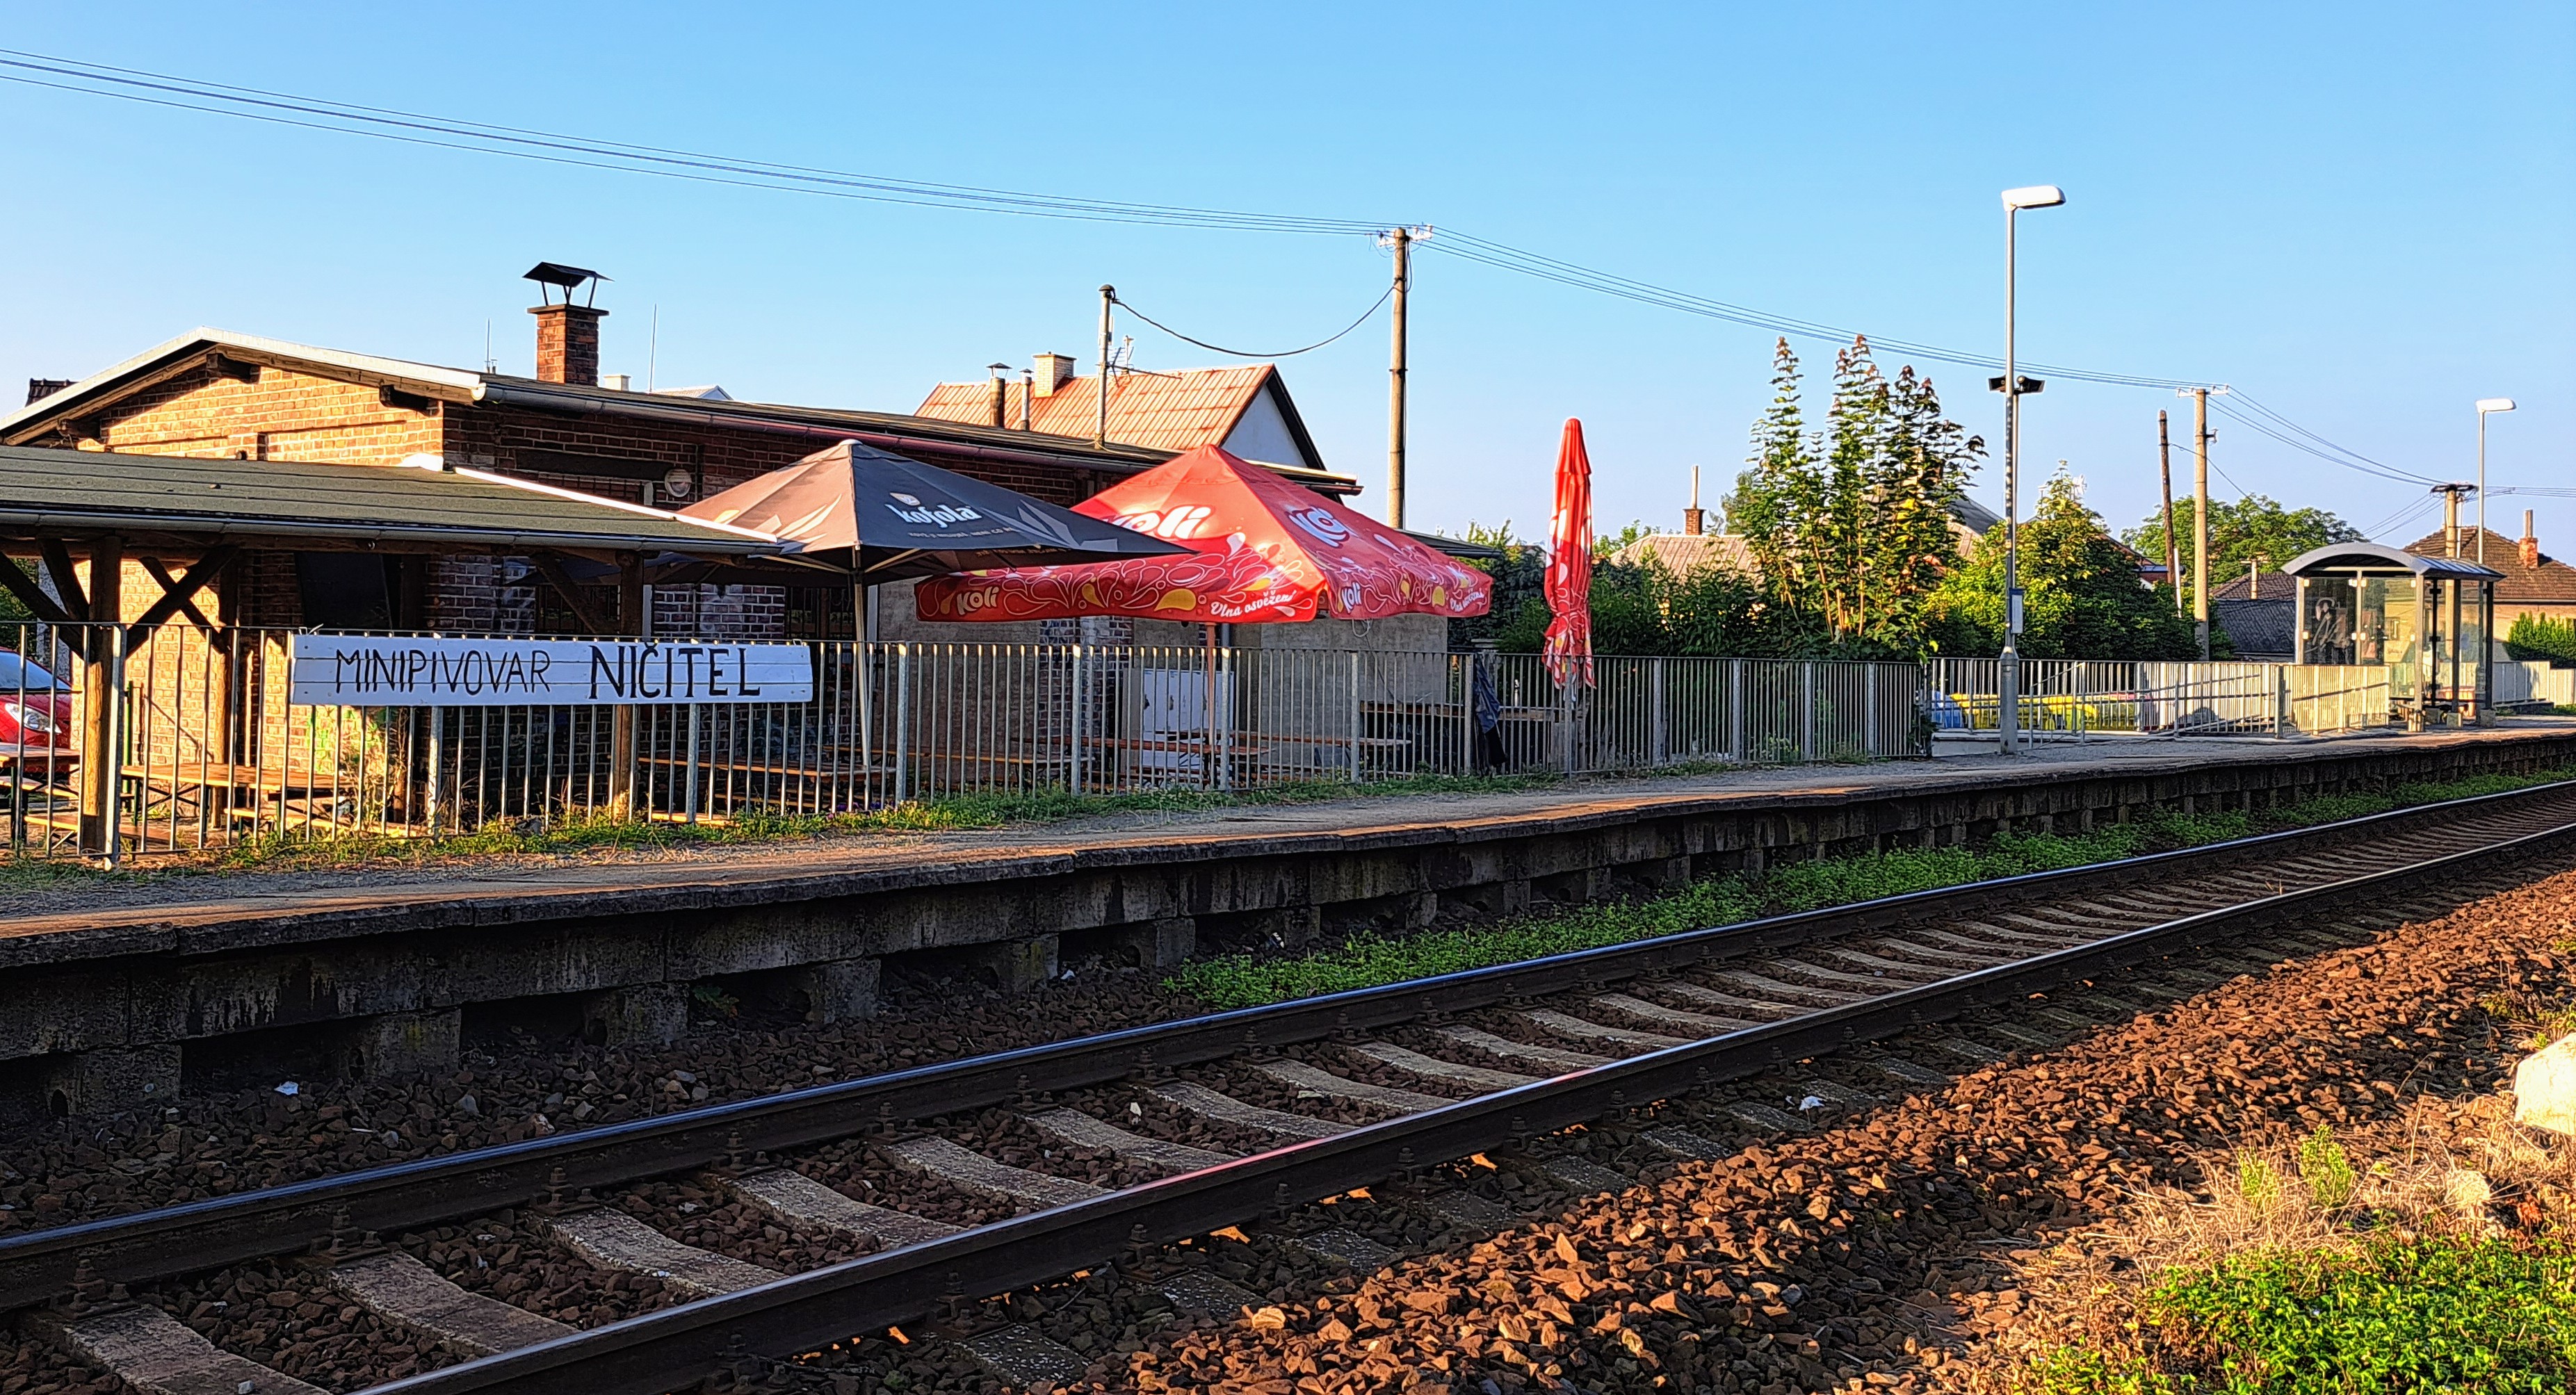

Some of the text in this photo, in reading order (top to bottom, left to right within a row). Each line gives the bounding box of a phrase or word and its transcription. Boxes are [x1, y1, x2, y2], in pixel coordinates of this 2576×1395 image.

[884, 503, 982, 528] kofola
[1104, 505, 1211, 539] oli
[336, 641, 761, 699] MINIPIVOVAR NIČITEL
